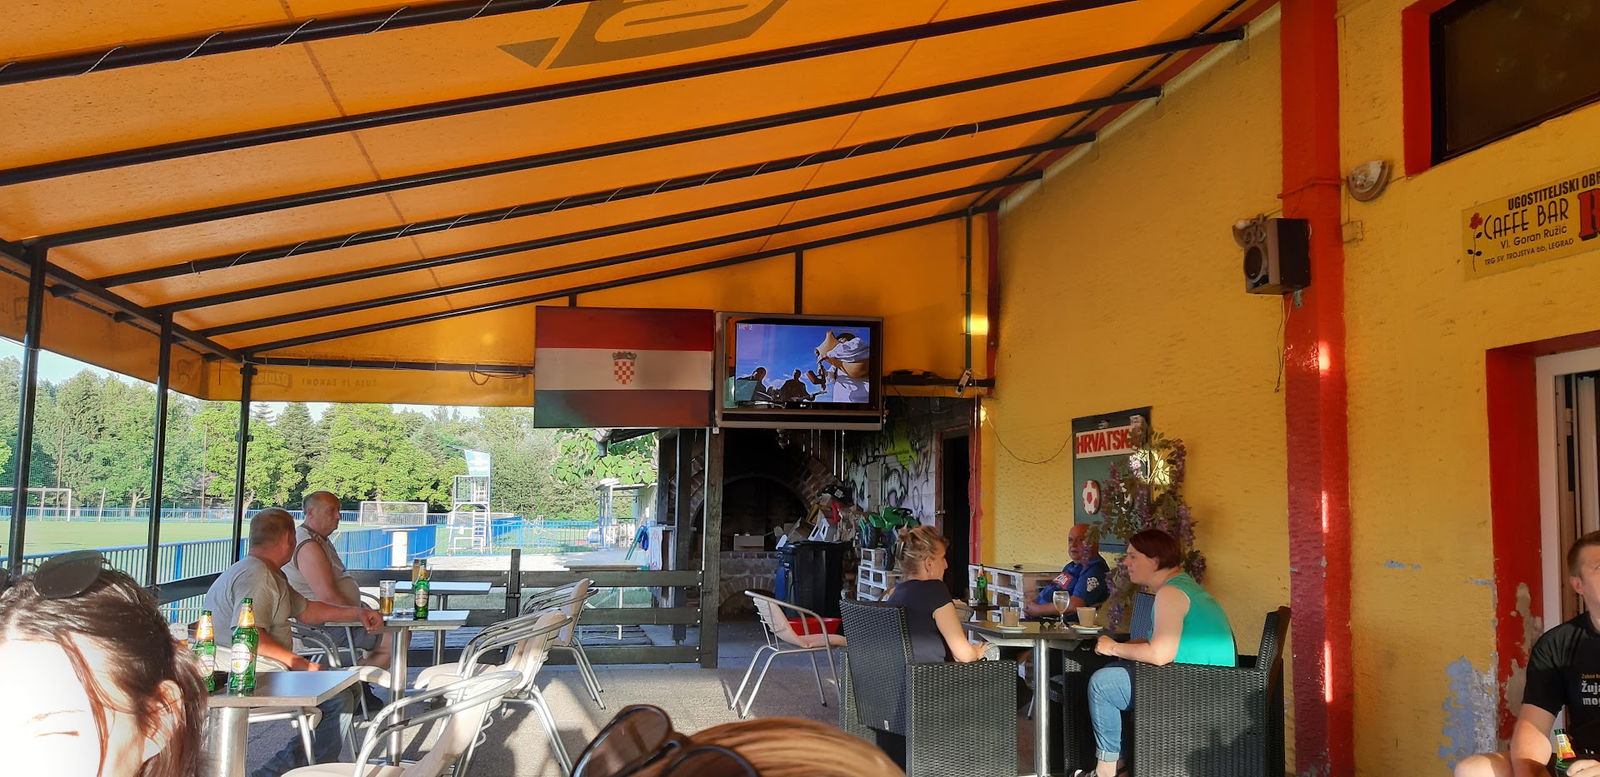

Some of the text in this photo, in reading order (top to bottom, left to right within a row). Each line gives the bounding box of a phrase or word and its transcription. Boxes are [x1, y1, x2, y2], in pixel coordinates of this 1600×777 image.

[1508, 178, 1579, 210] UGOSTITELJSKI
[1484, 198, 1569, 240] CAFFE BAR
[1506, 248, 1535, 260] TROJSTVA
[1548, 238, 1574, 250] LEGRAD
[1514, 233, 1541, 246] Goran
[1076, 428, 1134, 454] HRVATSK
[1583, 697, 1600, 707] mo
